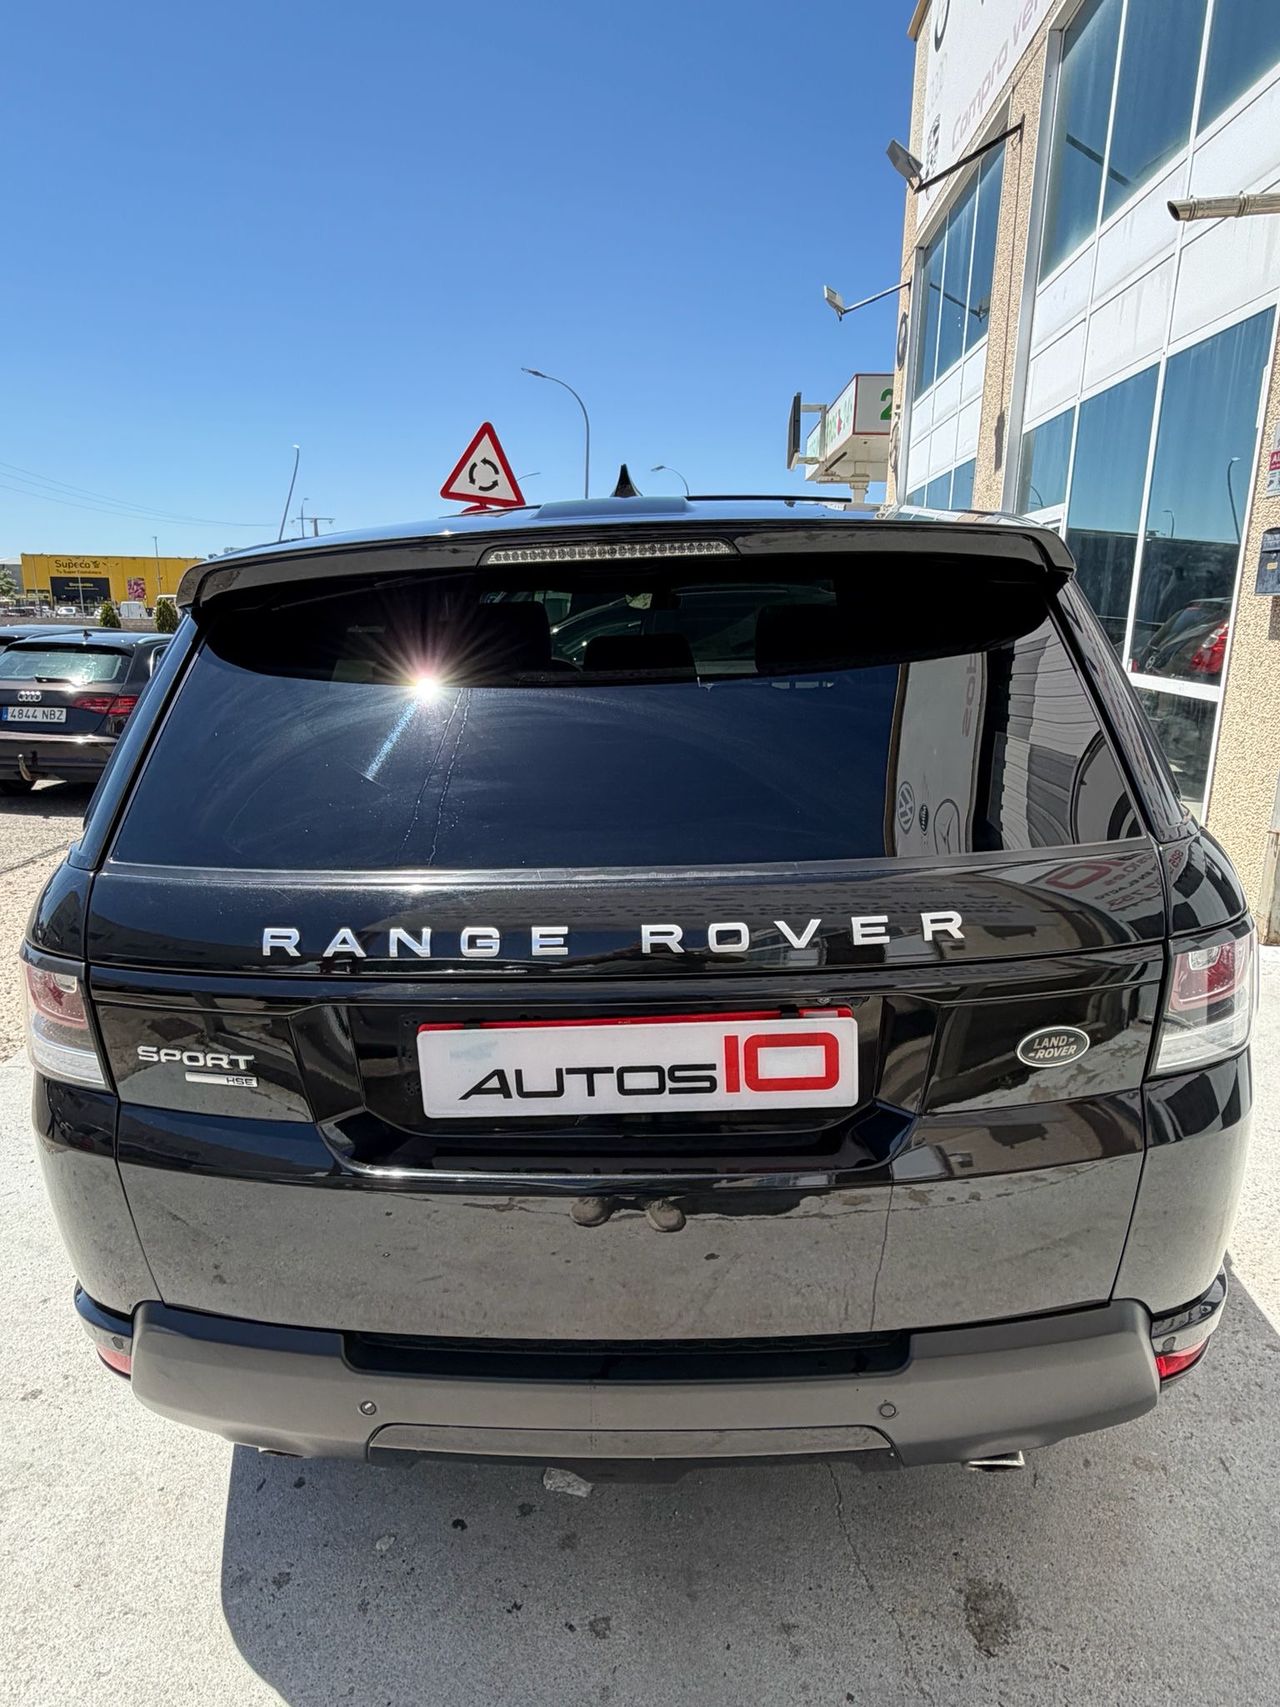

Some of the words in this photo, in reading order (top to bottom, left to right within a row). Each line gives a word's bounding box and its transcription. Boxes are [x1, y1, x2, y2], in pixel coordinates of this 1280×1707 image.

[10, 708, 38, 719] 4844
[41, 709, 64, 721] NBZ
[262, 926, 569, 958] RANGE
[641, 910, 966, 954] ROVER
[137, 1045, 255, 1070] SPORT
[225, 1076, 255, 1086] HSE
